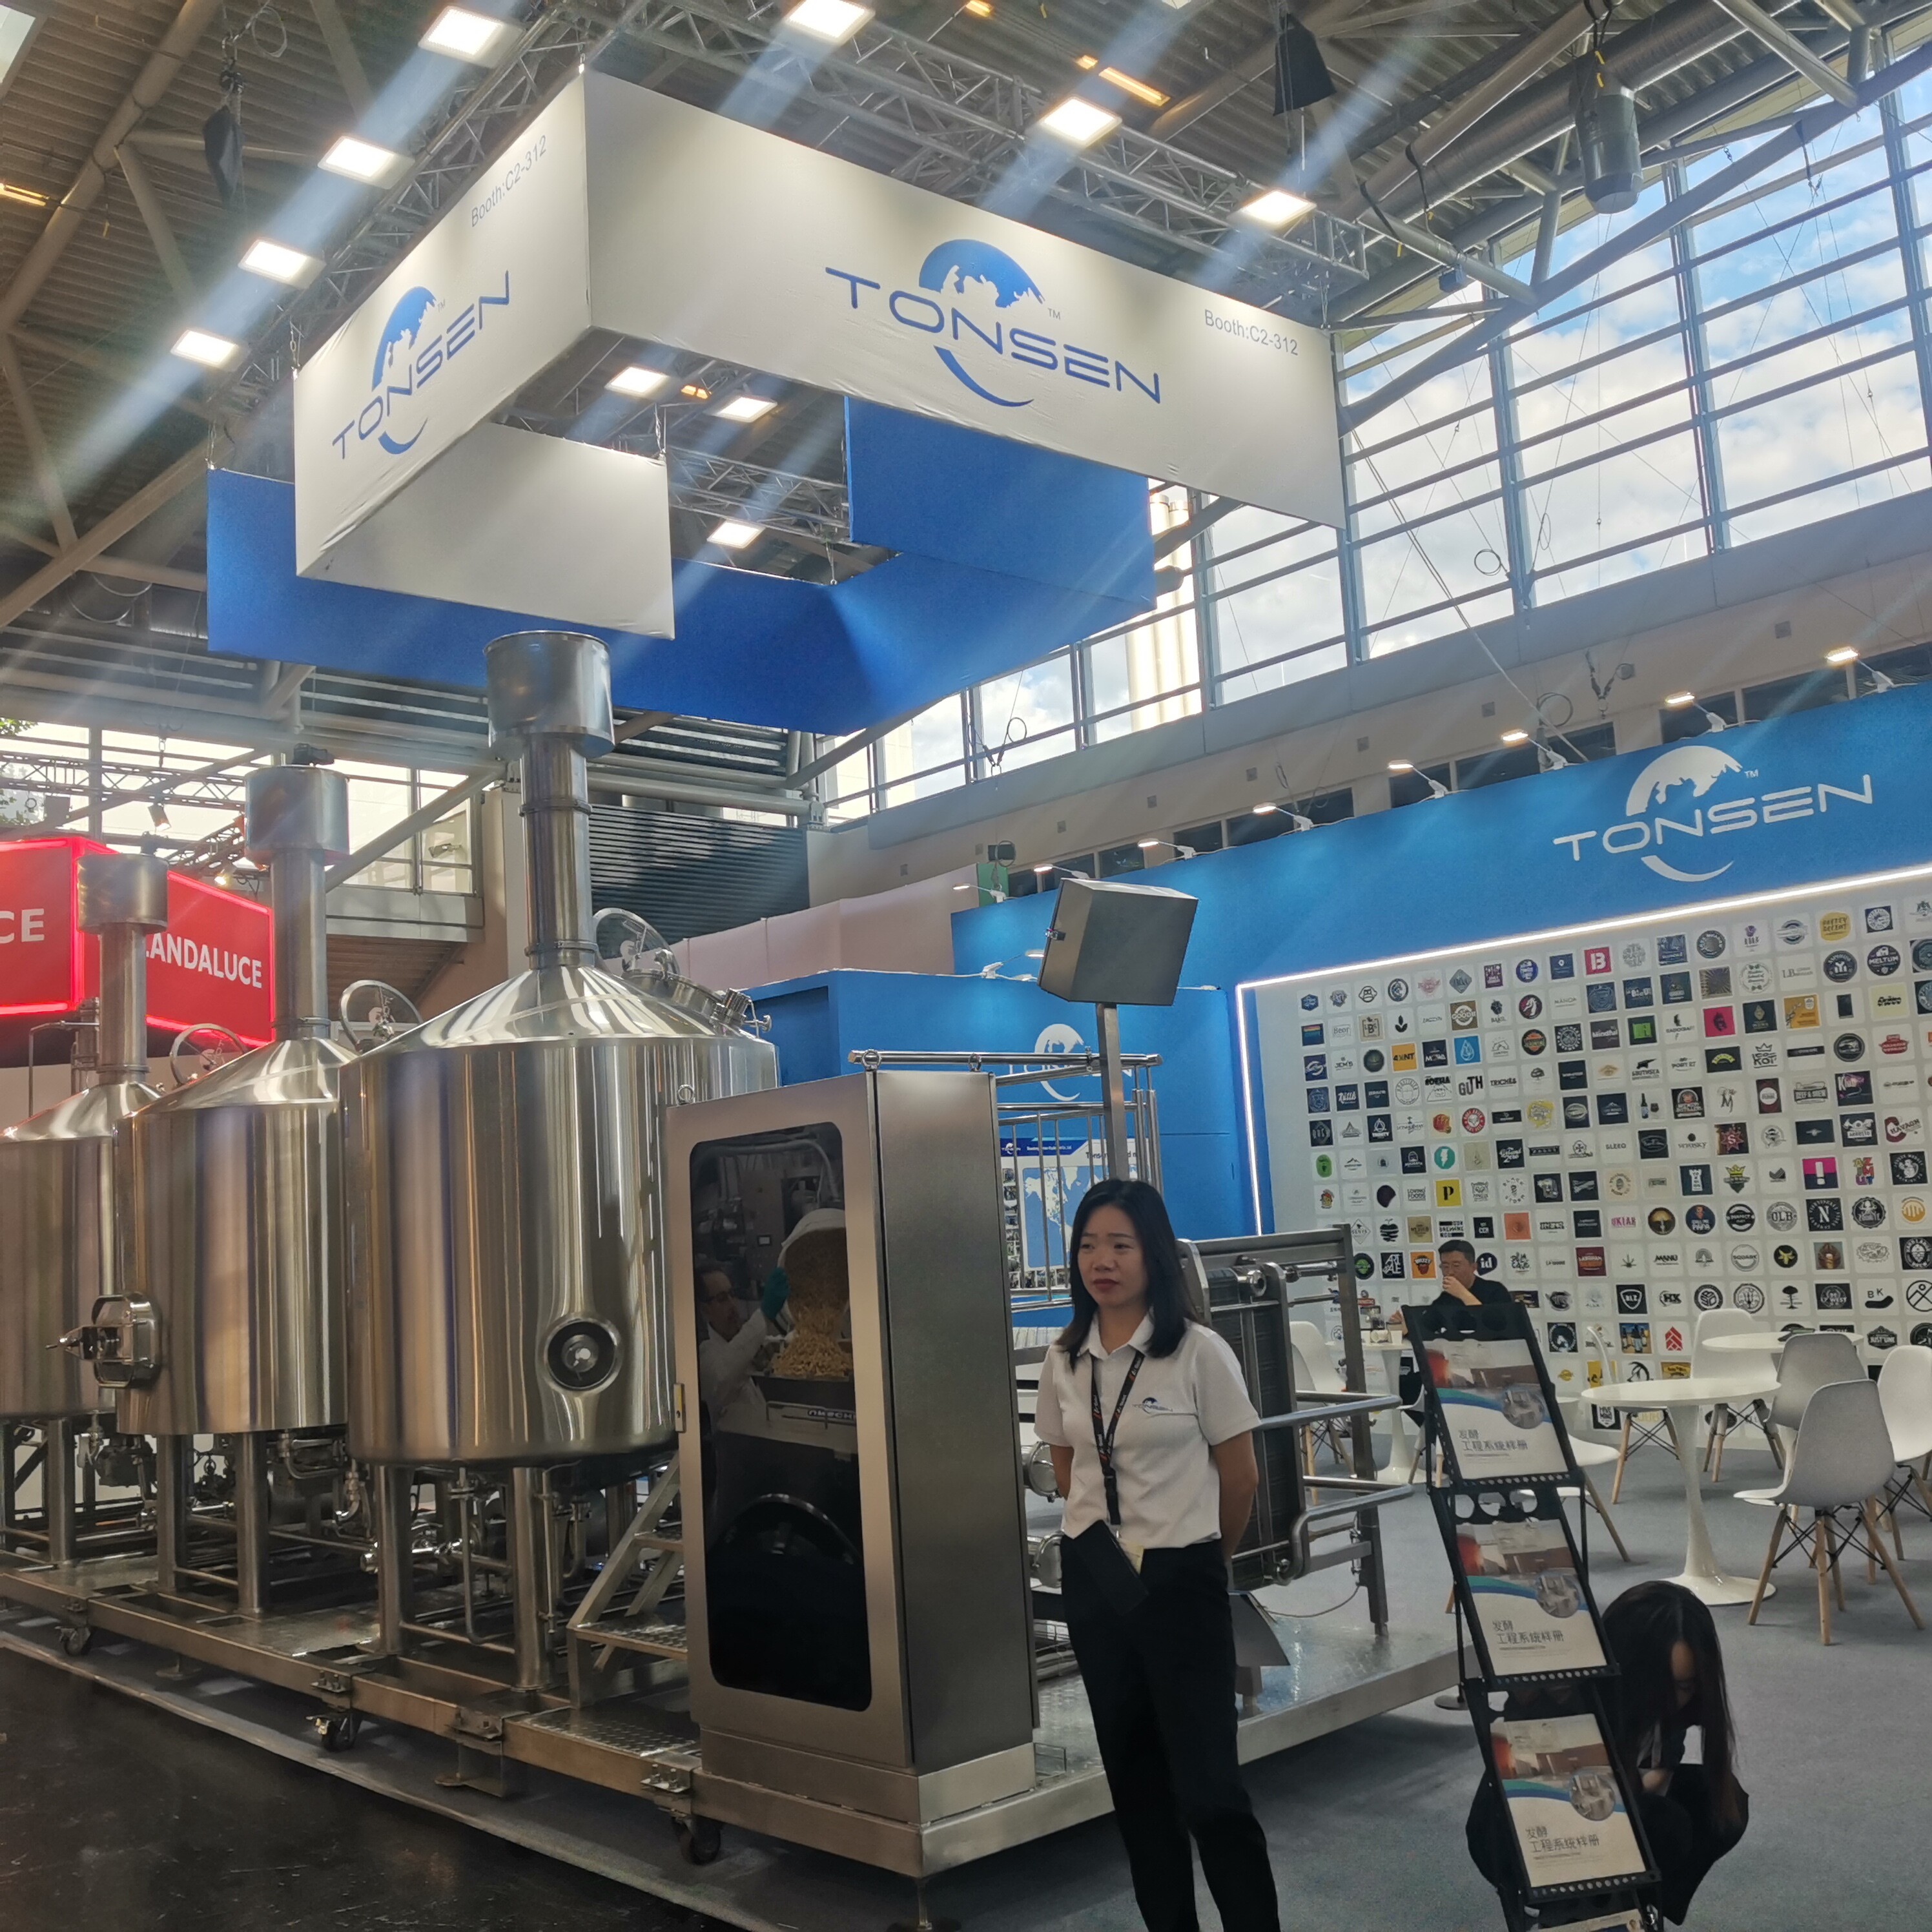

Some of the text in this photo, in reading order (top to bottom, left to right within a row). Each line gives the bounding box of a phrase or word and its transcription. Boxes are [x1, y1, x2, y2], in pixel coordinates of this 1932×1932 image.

[471, 134, 547, 227] Booth:C2-312
[333, 270, 510, 459] TONSEN
[825, 266, 1161, 404] TONSEN
[1204, 309, 1299, 356] Booth:C2-312
[1553, 774, 1873, 861] TONSEN
[146, 932, 263, 989] ANDALUCE
[1480, 1257, 1493, 1269] id
